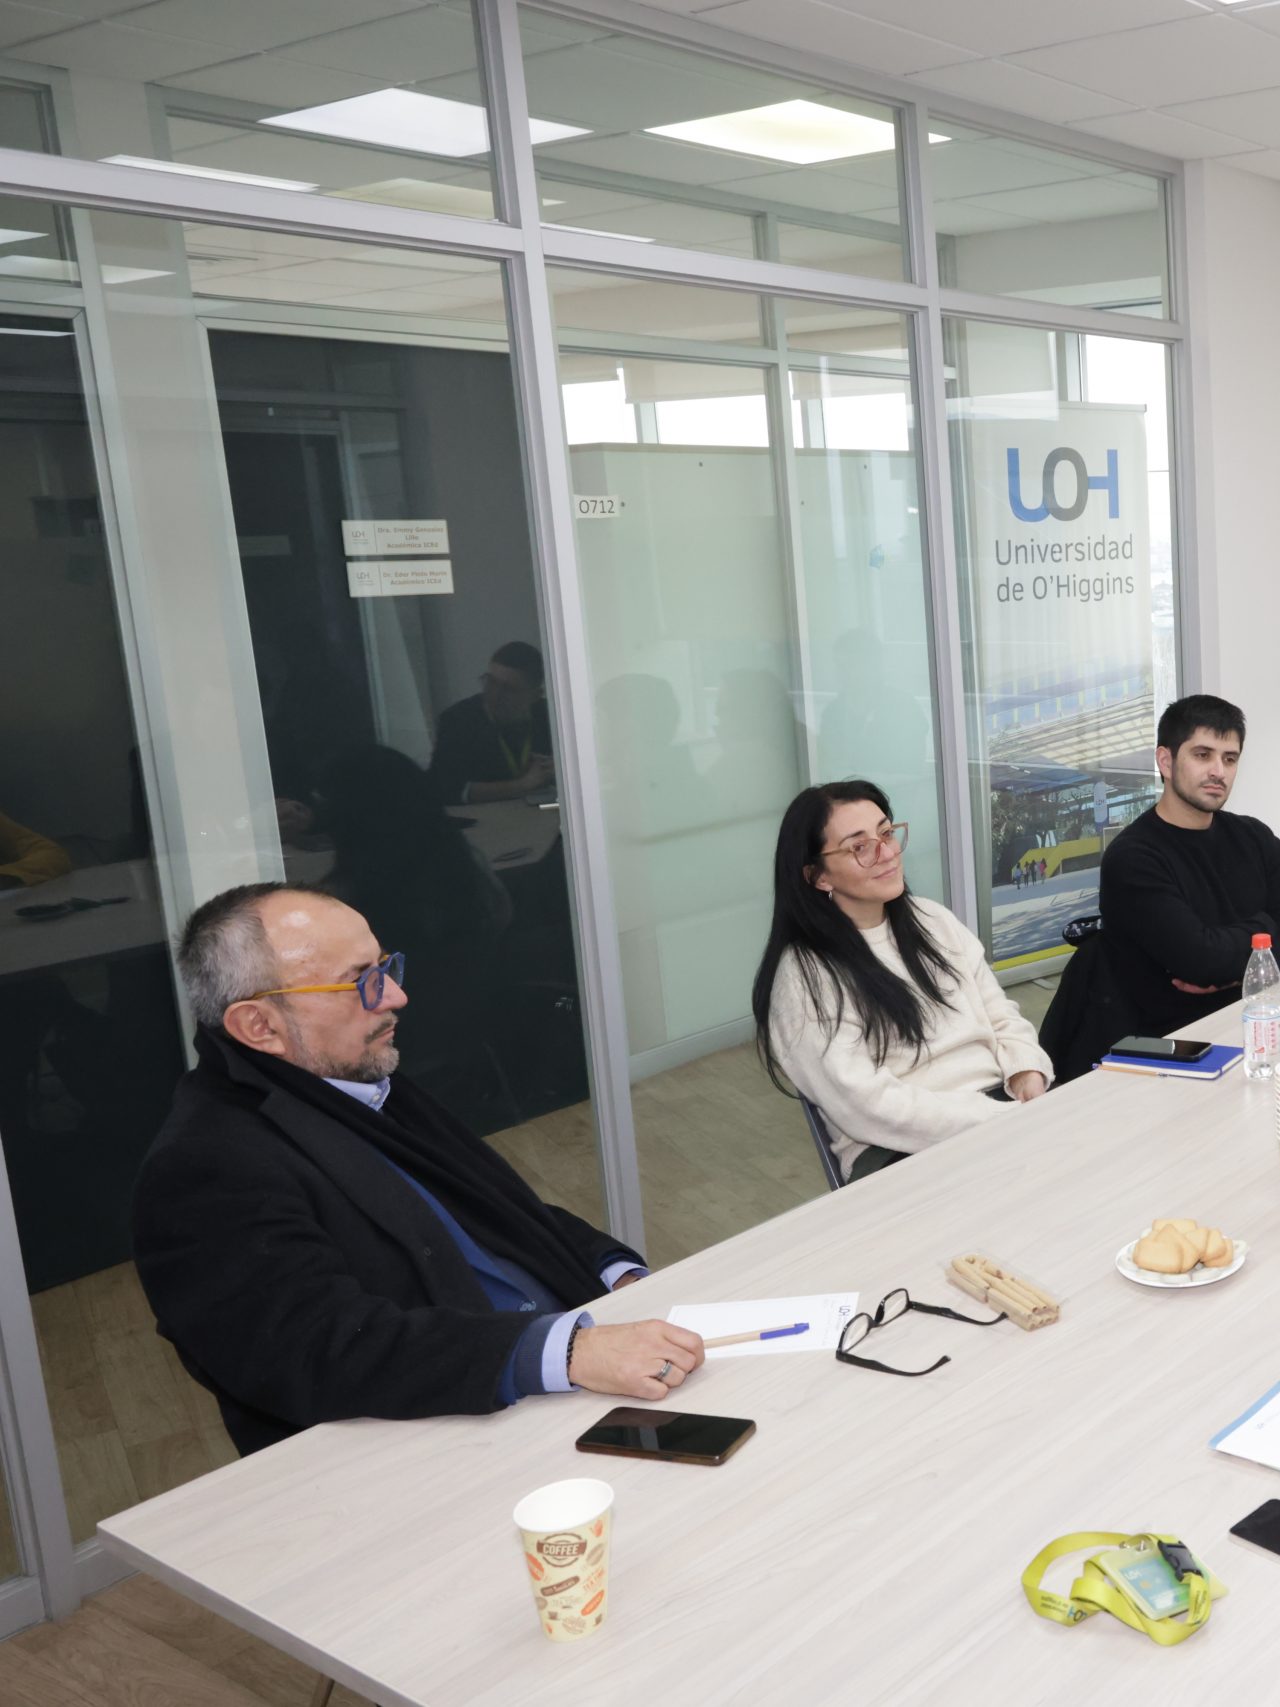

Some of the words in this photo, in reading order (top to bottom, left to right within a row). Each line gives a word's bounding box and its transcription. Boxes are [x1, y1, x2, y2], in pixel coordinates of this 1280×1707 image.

[1007, 447, 1119, 523] UOH
[995, 533, 1134, 566] Universidad
[996, 576, 1025, 602] de
[1032, 572, 1135, 602] O'Higgins
[543, 1543, 579, 1554] COFFEE
